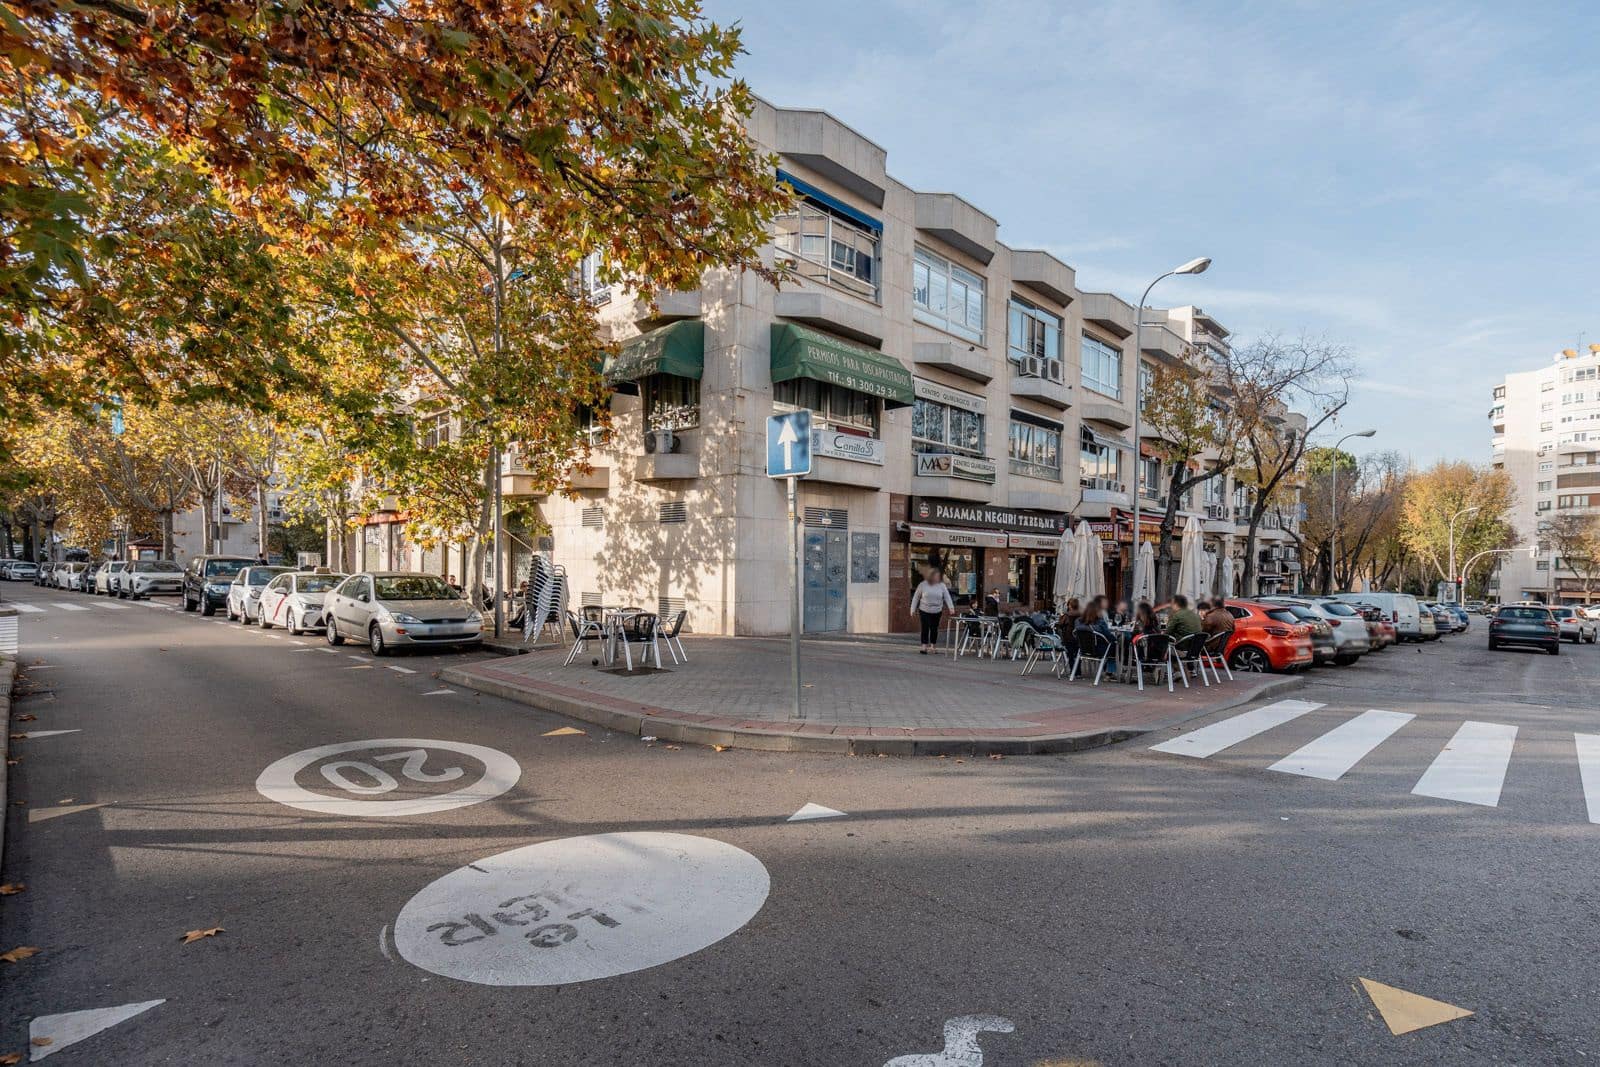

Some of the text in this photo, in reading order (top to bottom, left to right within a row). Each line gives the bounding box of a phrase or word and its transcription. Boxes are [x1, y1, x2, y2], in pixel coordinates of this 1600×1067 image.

[807, 345, 909, 387] PERMISOS PARA DISCAPACITADOS
[846, 376, 856, 388] 91
[859, 379, 874, 392] 300
[921, 387, 940, 398] CENTRO
[920, 456, 950, 471] MAG
[953, 459, 970, 468] CENTRO
[936, 504, 983, 522] PASAMAR
[985, 511, 1017, 525] NEGURI
[1018, 515, 1055, 529] TABERNA
[320, 749, 465, 795] 20
